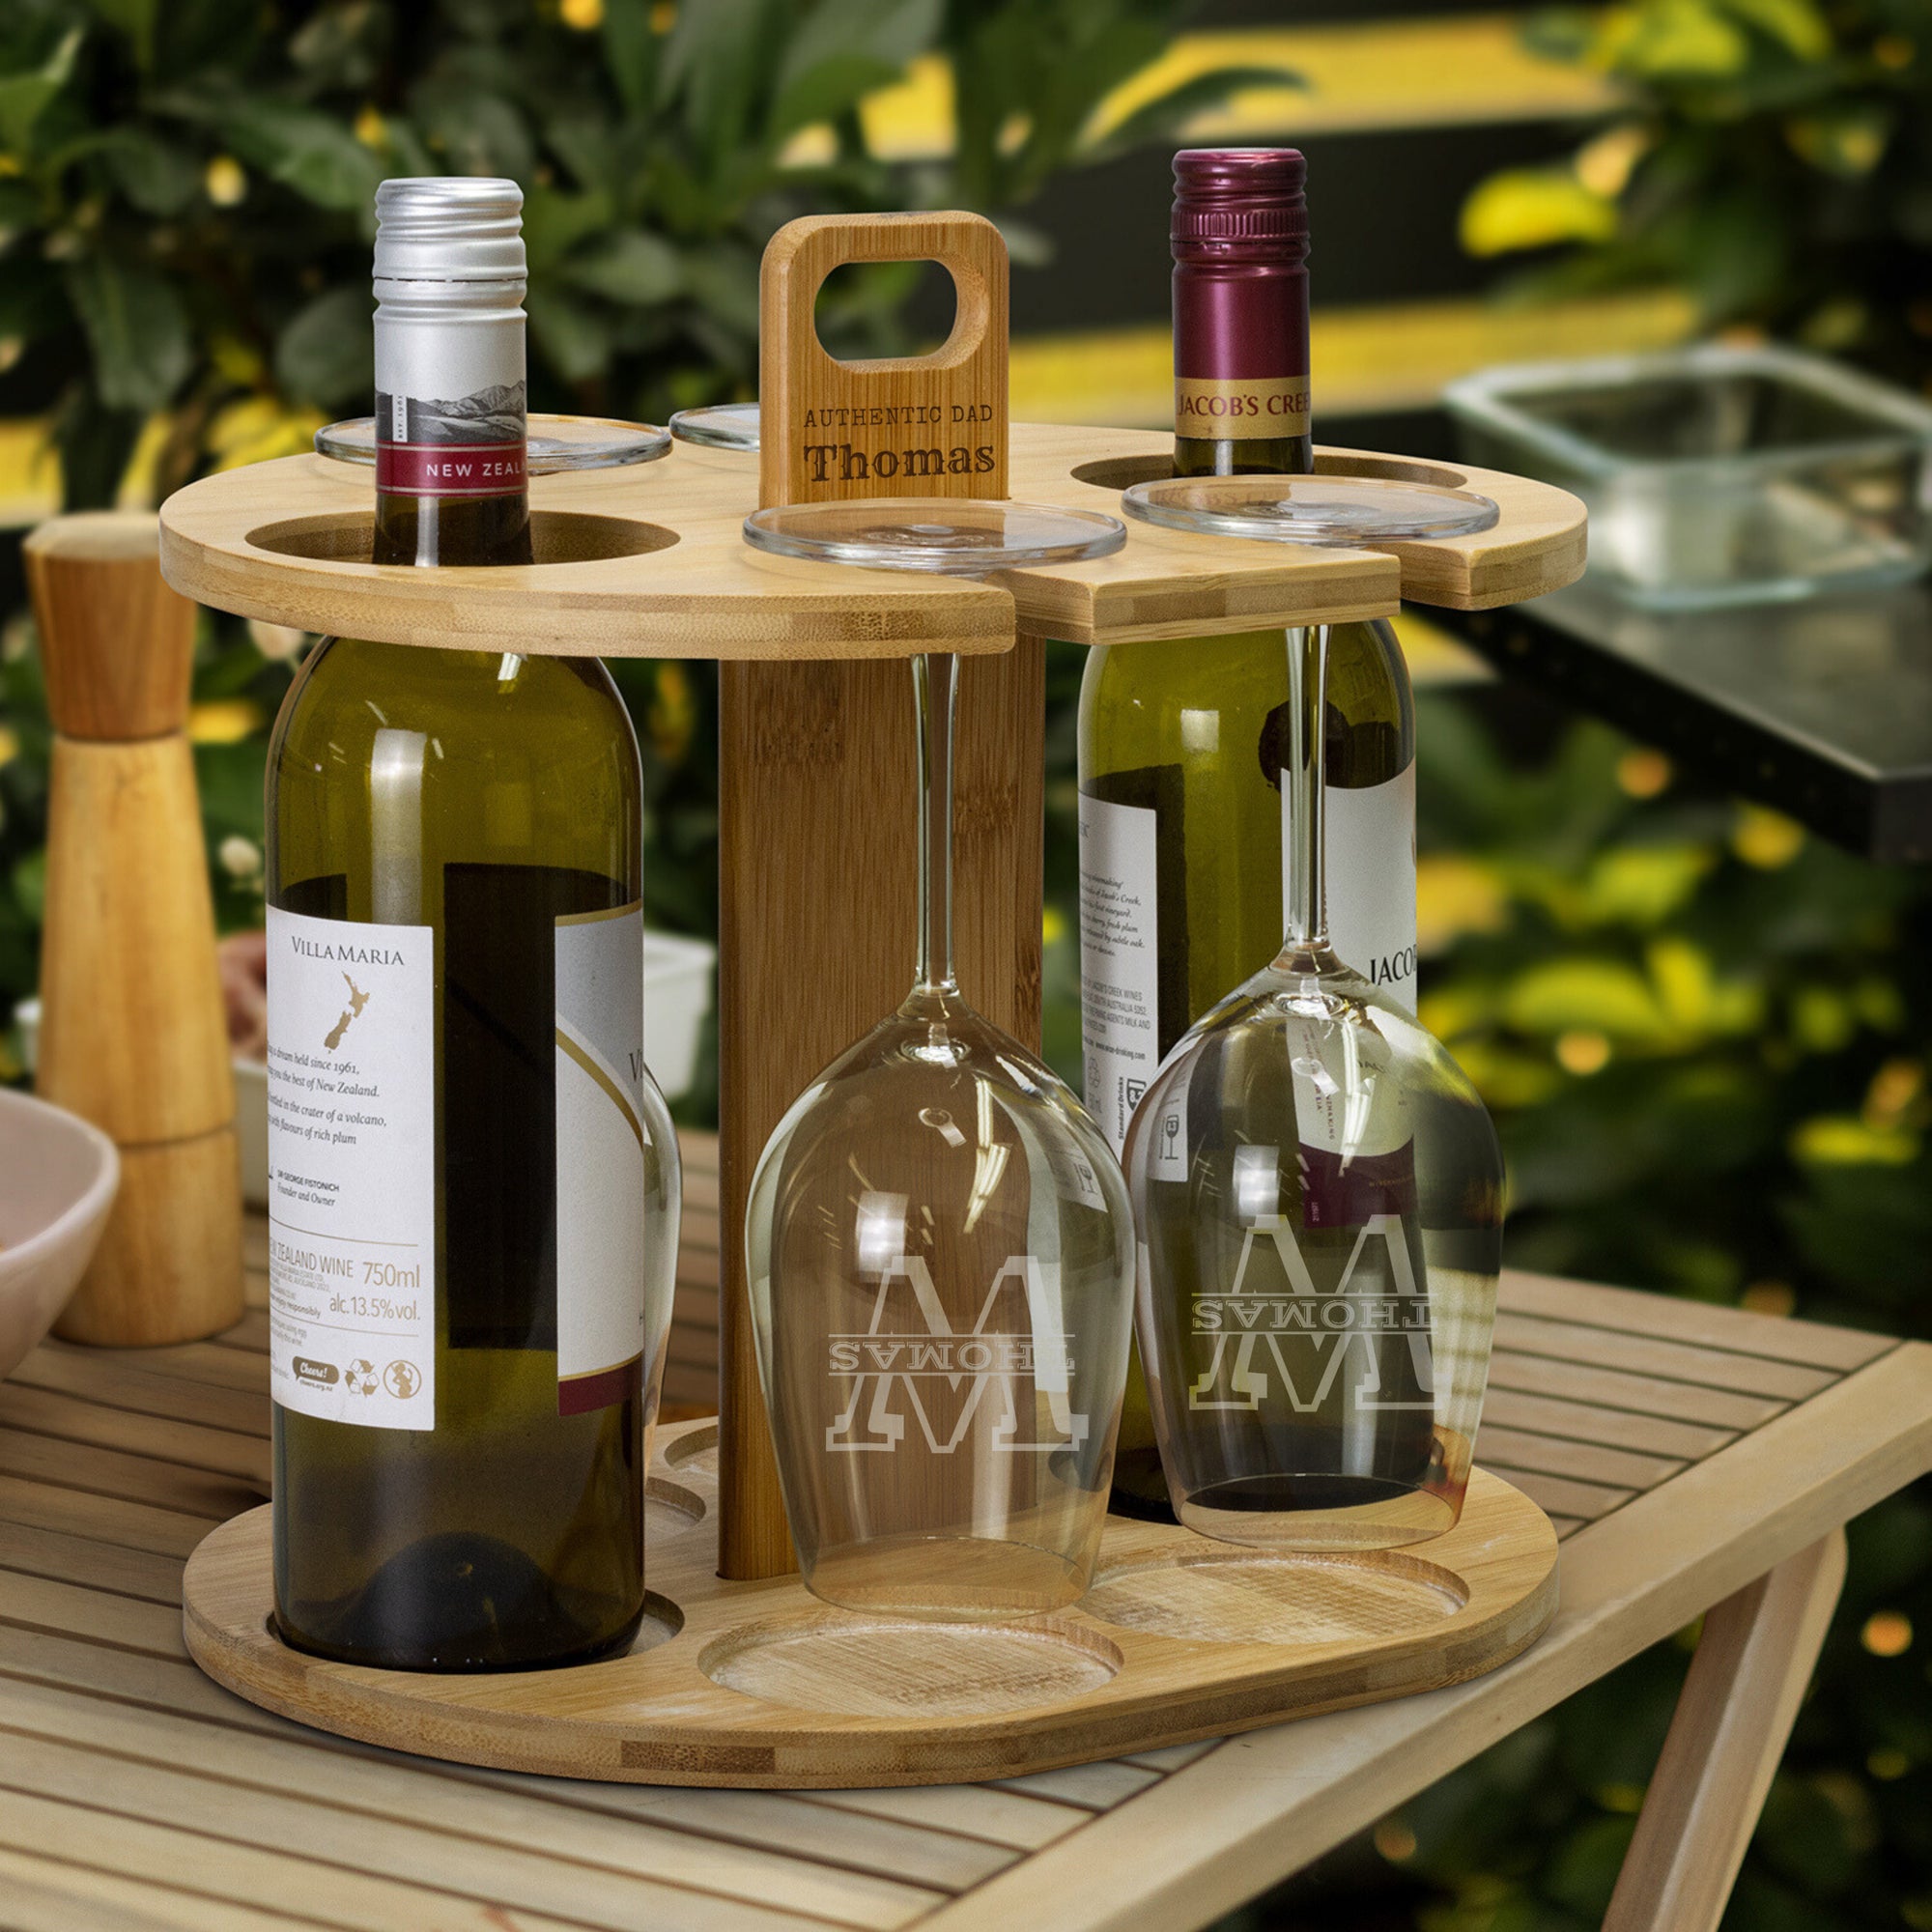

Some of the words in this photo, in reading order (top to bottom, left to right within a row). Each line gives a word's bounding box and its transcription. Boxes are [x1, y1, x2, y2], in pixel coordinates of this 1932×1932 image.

[804, 406, 942, 428] AUTHENTIC
[951, 404, 993, 423] DAD
[1179, 394, 1259, 416] JACOB'S
[426, 464, 472, 477] NEW
[804, 442, 996, 482] Thomas
[337, 944, 405, 966] MARIA
[294, 1052, 309, 1066] held
[310, 1057, 331, 1070] since
[292, 1072, 305, 1086] best
[306, 1077, 315, 1092] of
[316, 1077, 335, 1092] New
[337, 1081, 380, 1097] Zealand.
[290, 1100, 299, 1113] the
[300, 1105, 324, 1119] crater
[326, 1109, 336, 1123] of
[304, 1126, 313, 1140] of
[314, 1127, 330, 1141] rich
[332, 1131, 356, 1145] plum
[298, 1190, 309, 1202] and
[311, 1192, 335, 1207] Owner
[277, 1242, 317, 1271] ZEALAND
[319, 1255, 354, 1278] WINE
[363, 1262, 420, 1289] 750ml
[1192, 1299, 1438, 1328] THOMAS
[828, 1341, 1075, 1371] THOMAS
